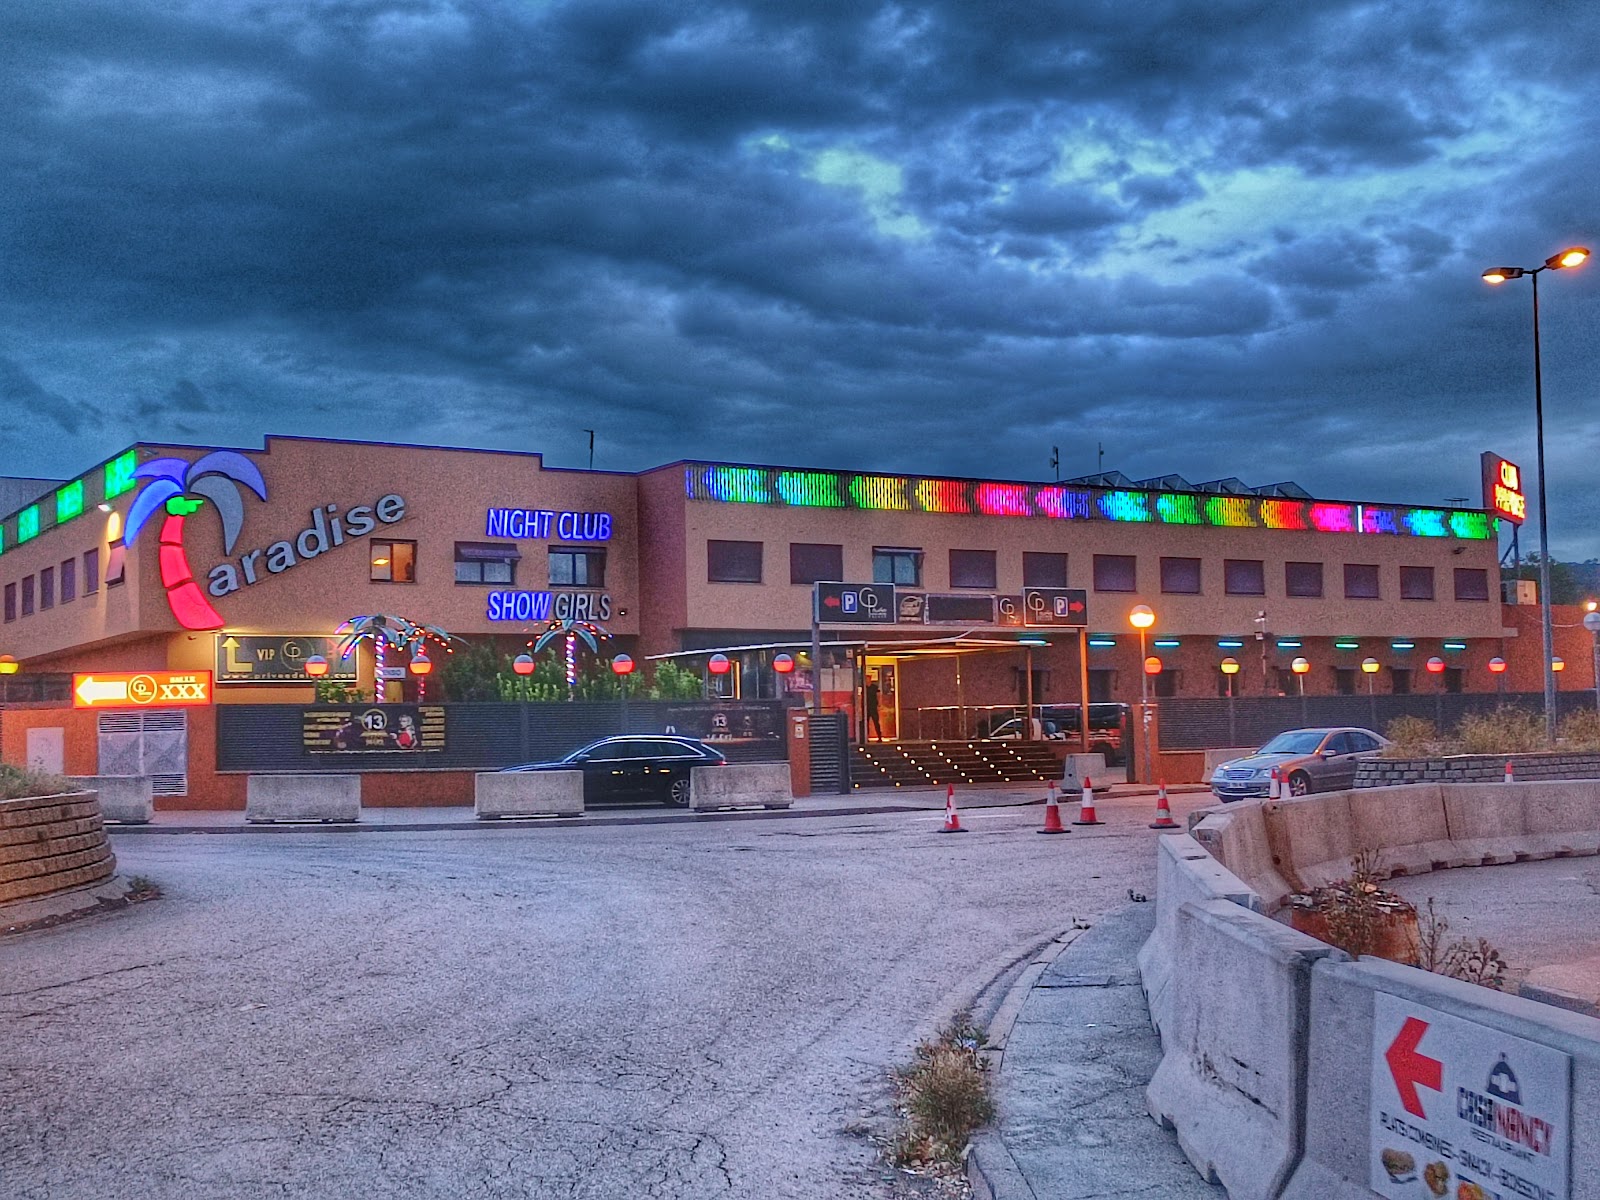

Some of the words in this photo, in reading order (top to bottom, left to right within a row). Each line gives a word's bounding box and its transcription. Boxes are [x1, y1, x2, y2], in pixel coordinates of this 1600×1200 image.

[487, 508, 554, 538] NIGHT
[558, 511, 612, 540] CLUB
[487, 591, 551, 620] SHOW
[555, 592, 611, 621] GIRLS
[159, 683, 206, 700] XXX
[365, 715, 383, 730] 13
